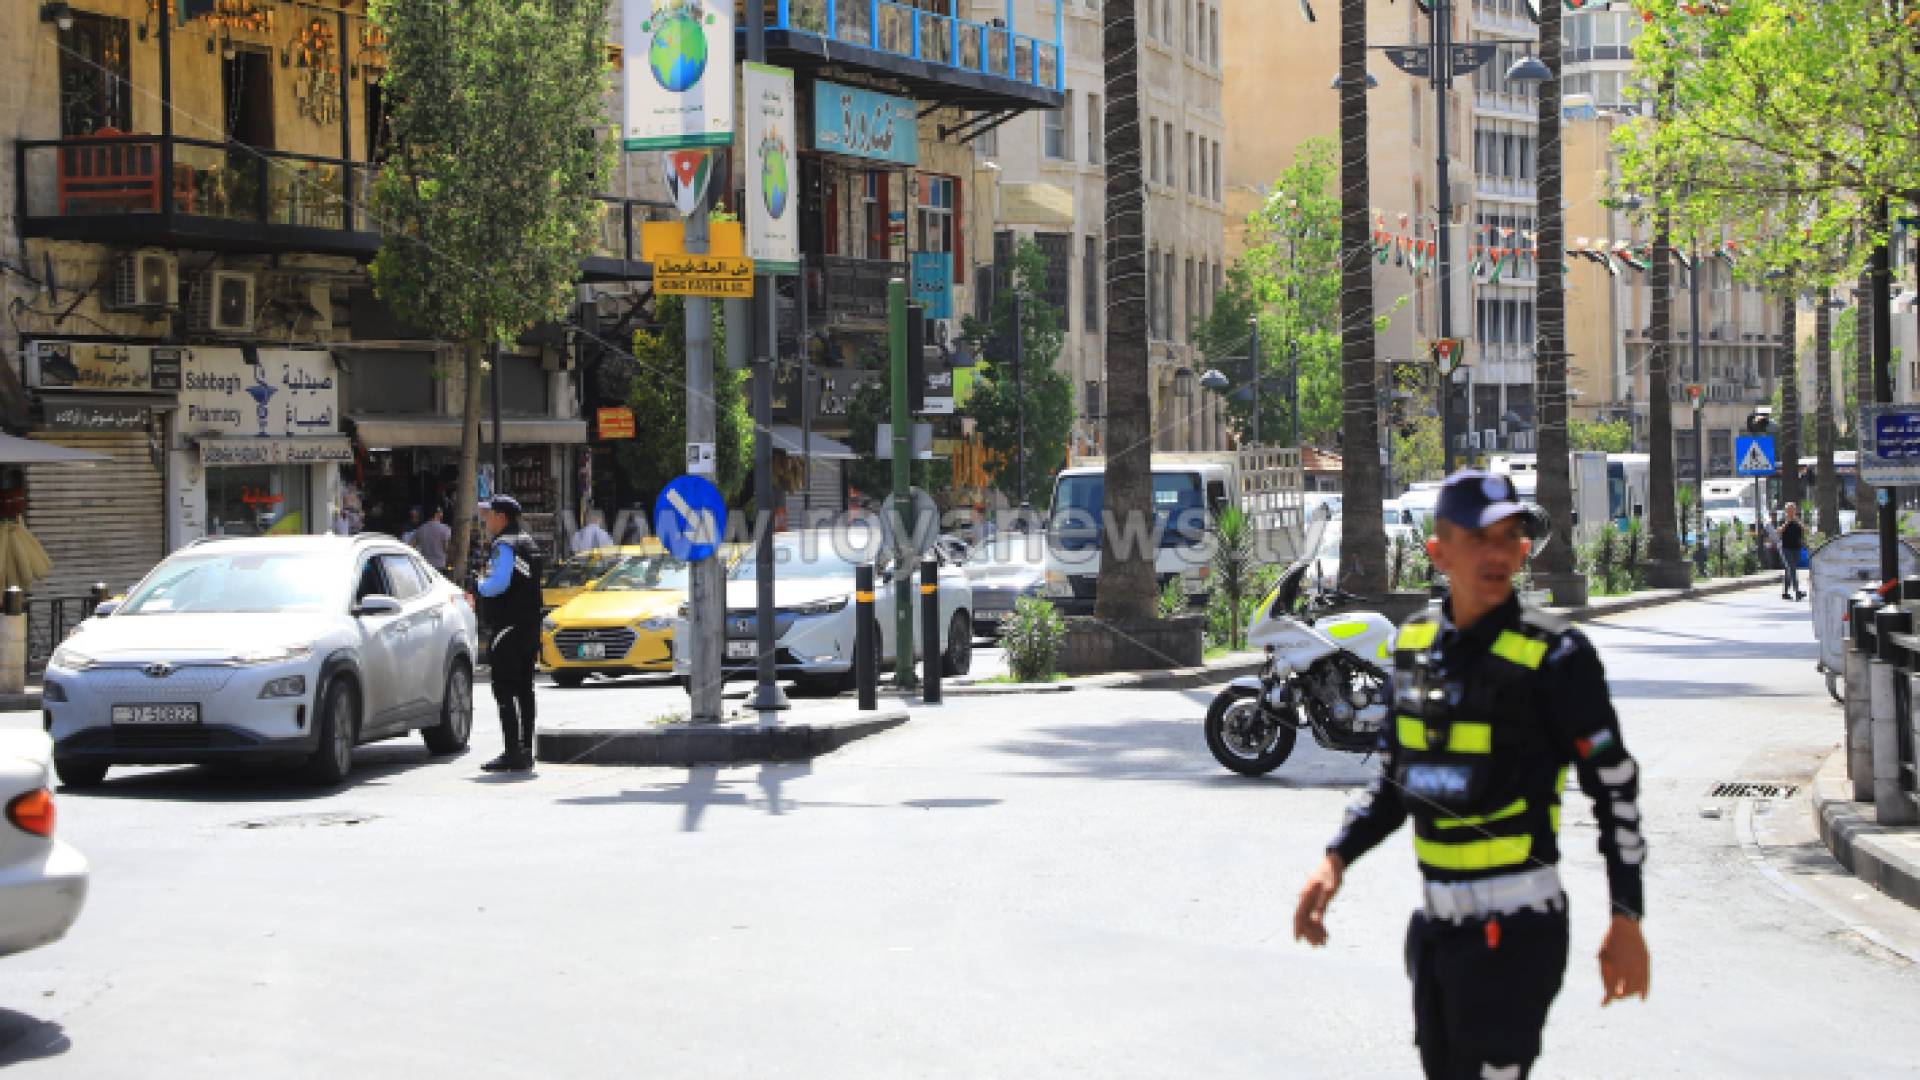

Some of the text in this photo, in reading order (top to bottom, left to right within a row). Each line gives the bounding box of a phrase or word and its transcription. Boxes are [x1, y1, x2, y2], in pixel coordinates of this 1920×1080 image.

[186, 372, 240, 395] Sabbagh
[283, 364, 332, 395] صيدلية
[188, 404, 241, 428] Pharmacy
